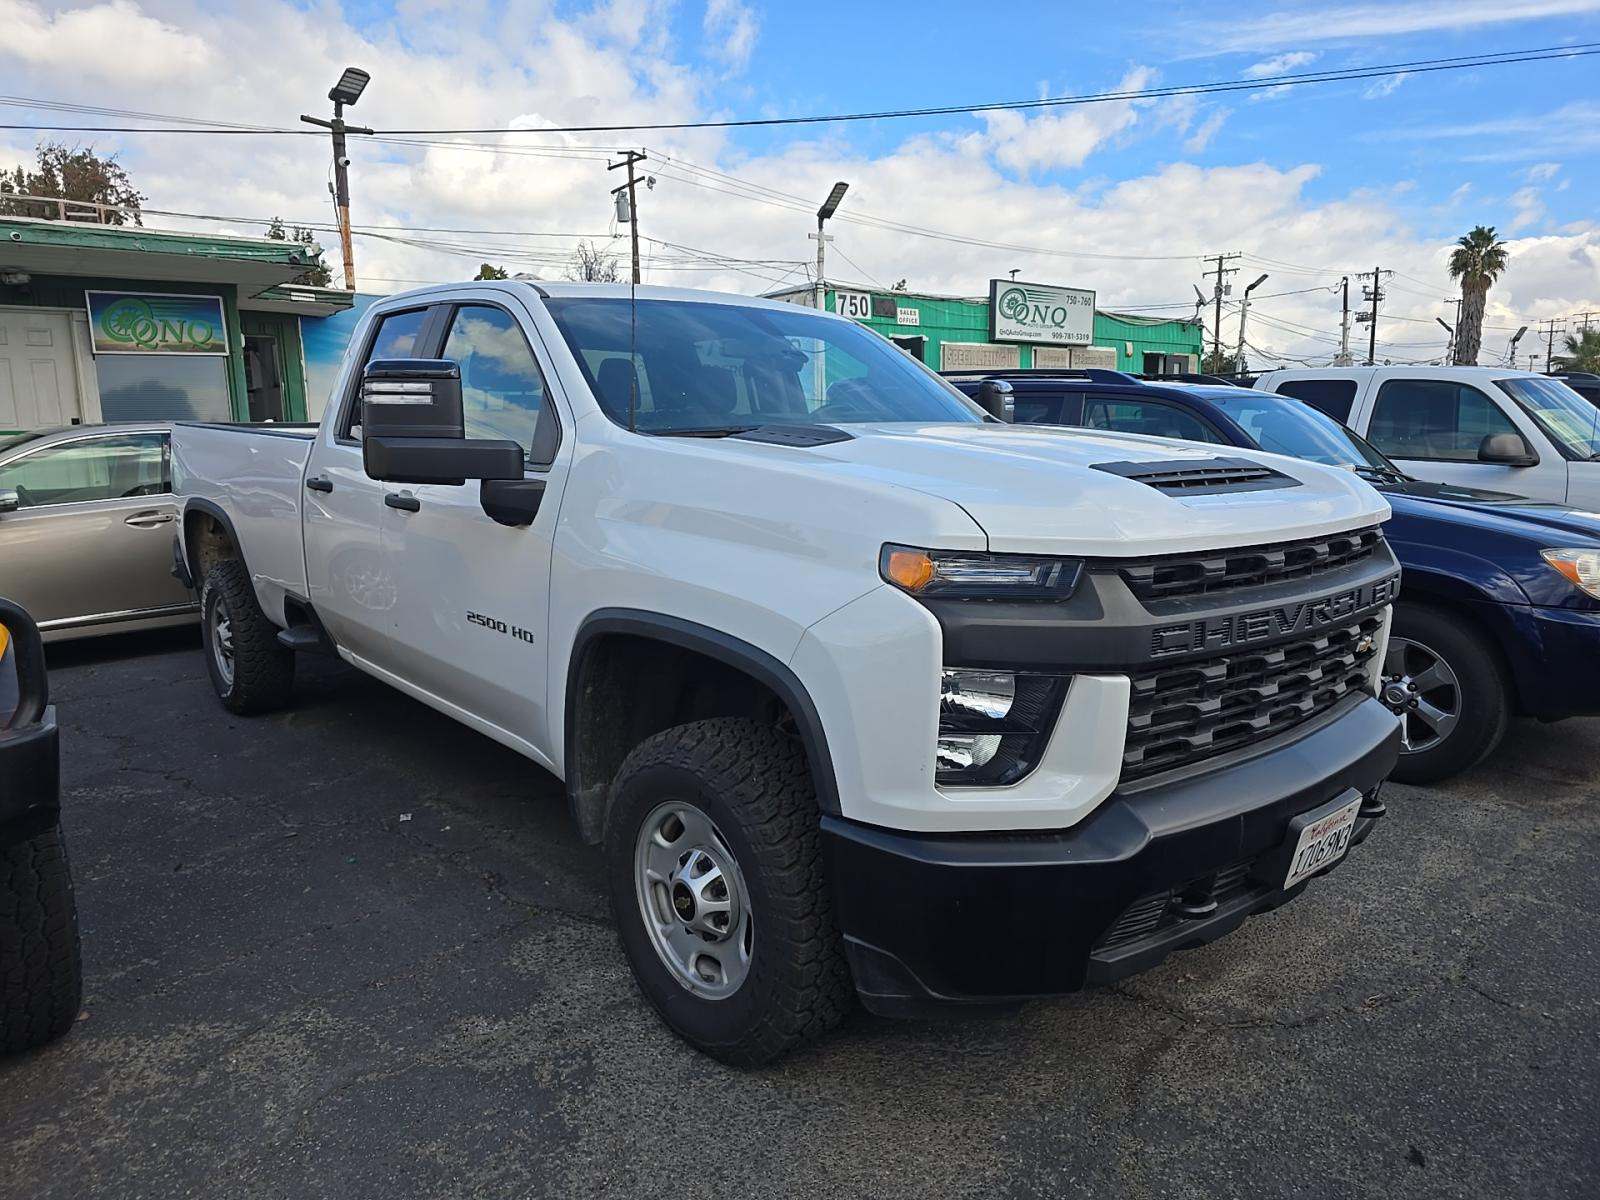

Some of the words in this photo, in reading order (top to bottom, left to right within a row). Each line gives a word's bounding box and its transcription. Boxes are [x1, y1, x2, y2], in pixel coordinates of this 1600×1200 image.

[837, 294, 869, 317] 750
[899, 309, 917, 317] SALES
[898, 317, 919, 325] OFFICE
[1051, 331, 1090, 341] 909-781-5319
[1150, 572, 1400, 658] CHEVROLET
[466, 610, 507, 633] 2500
[511, 626, 534, 644] HD
